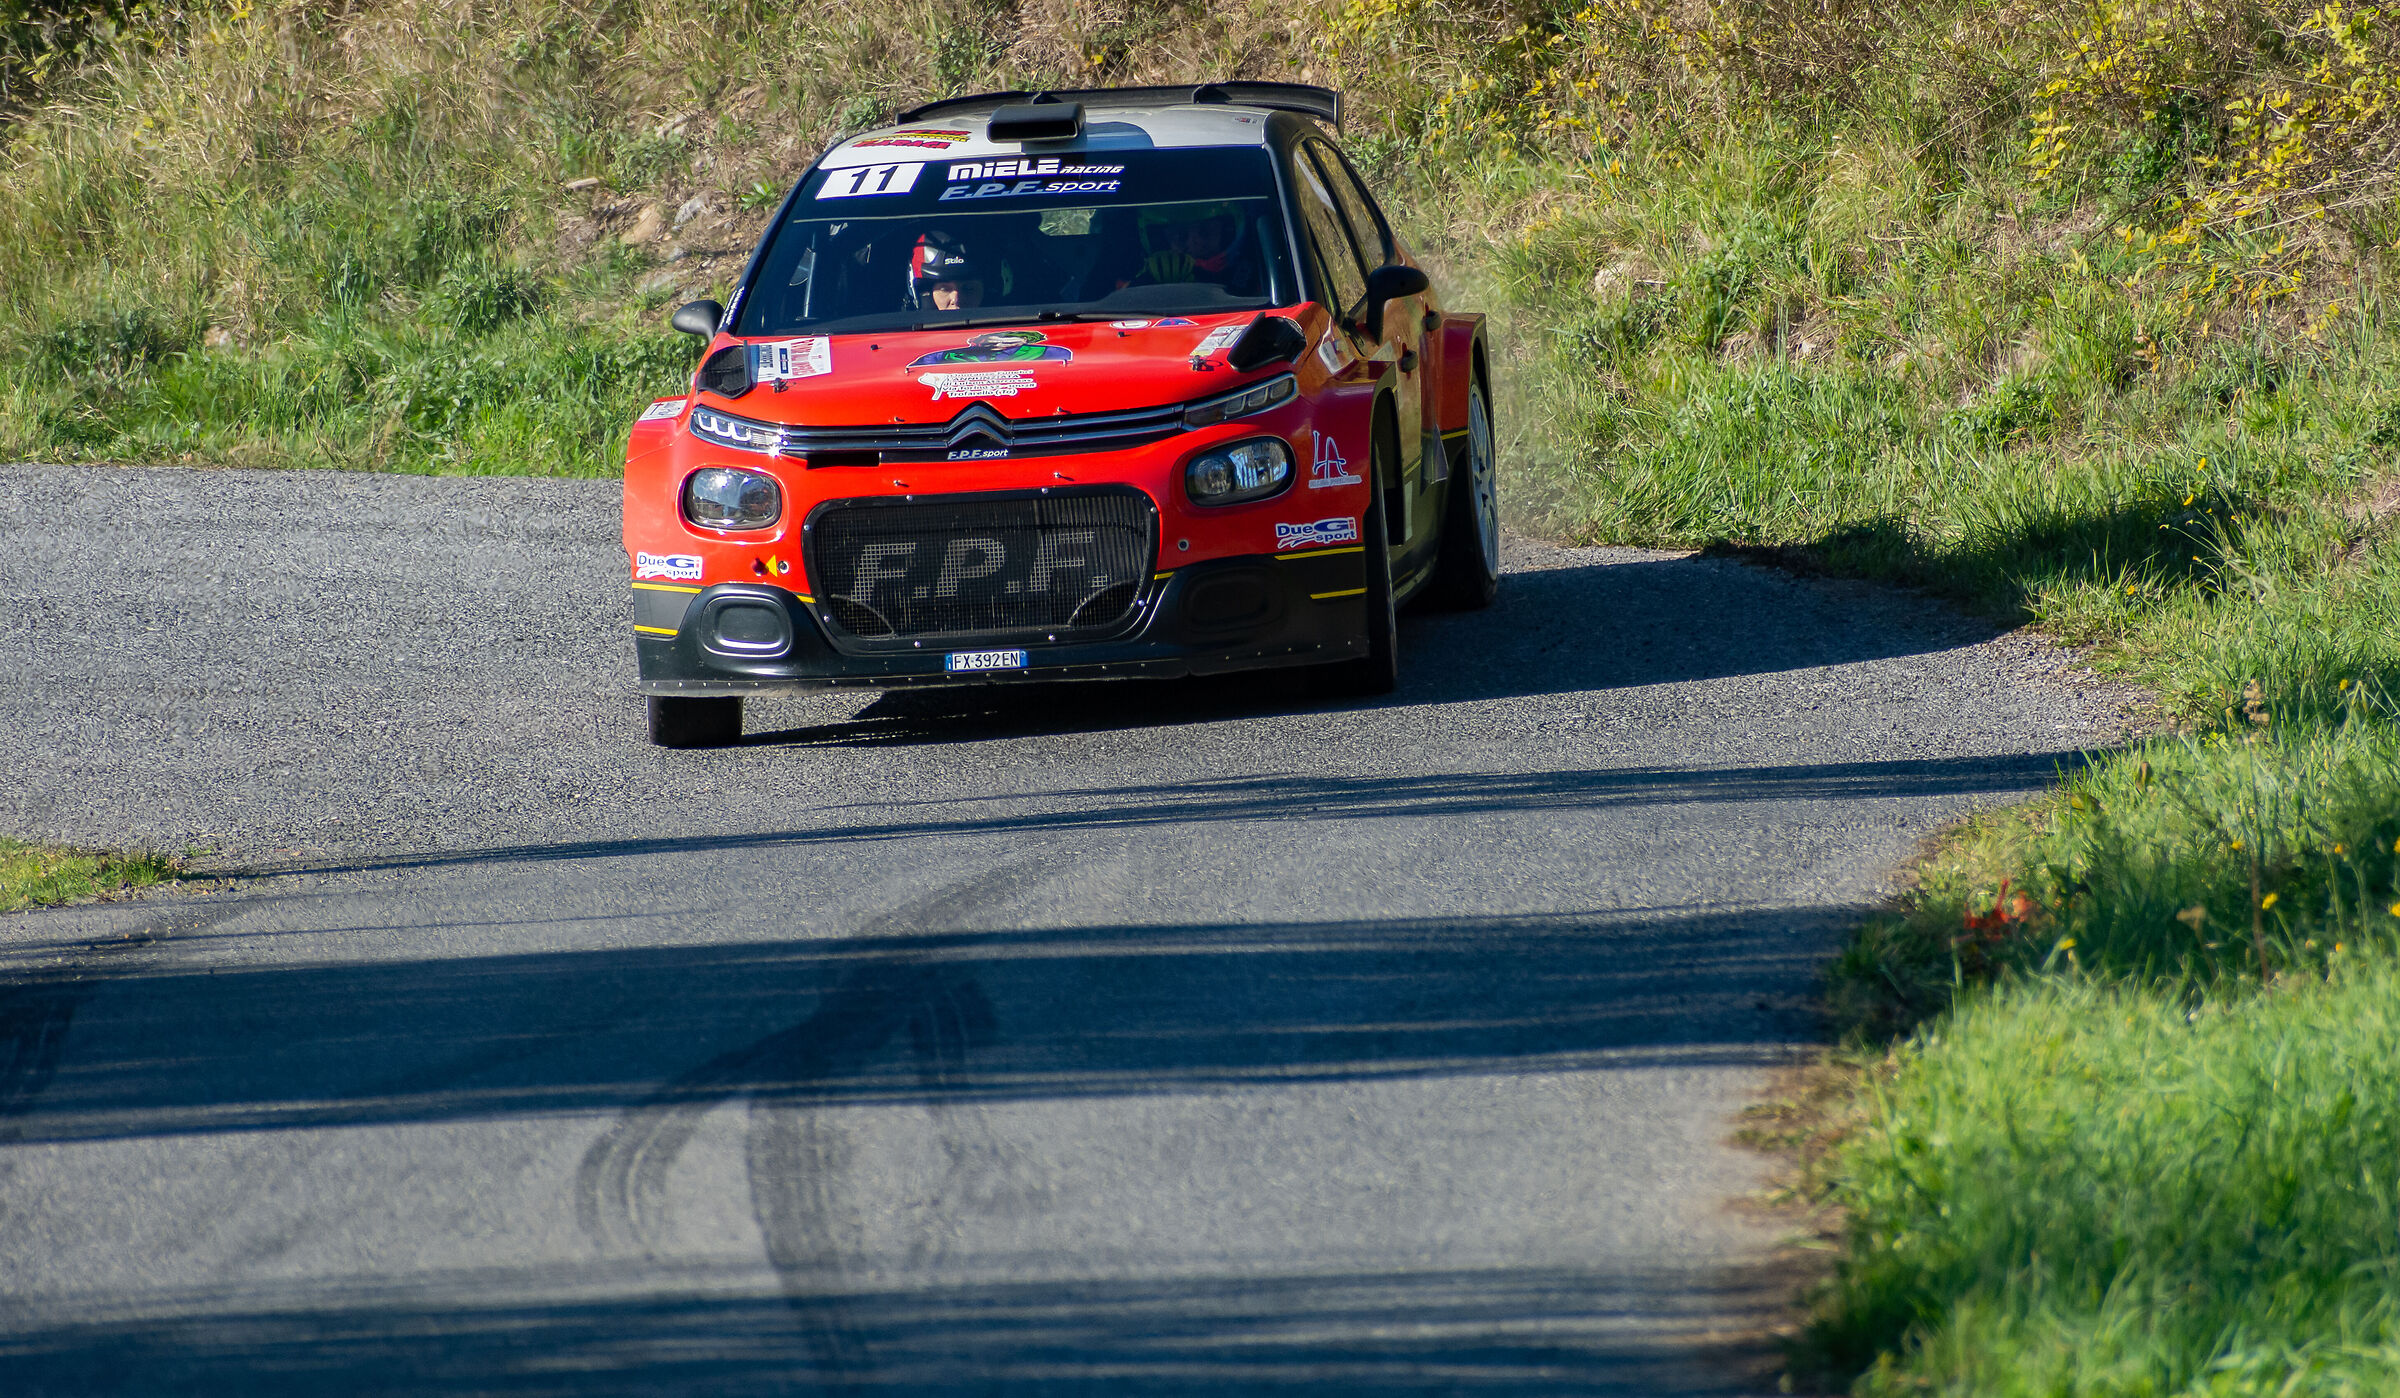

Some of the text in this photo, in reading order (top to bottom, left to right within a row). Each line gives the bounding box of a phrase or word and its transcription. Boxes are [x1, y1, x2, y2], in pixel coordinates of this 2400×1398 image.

[848, 165, 900, 195] 11
[1315, 531, 1356, 542] sport
[666, 569, 699, 577] sport
